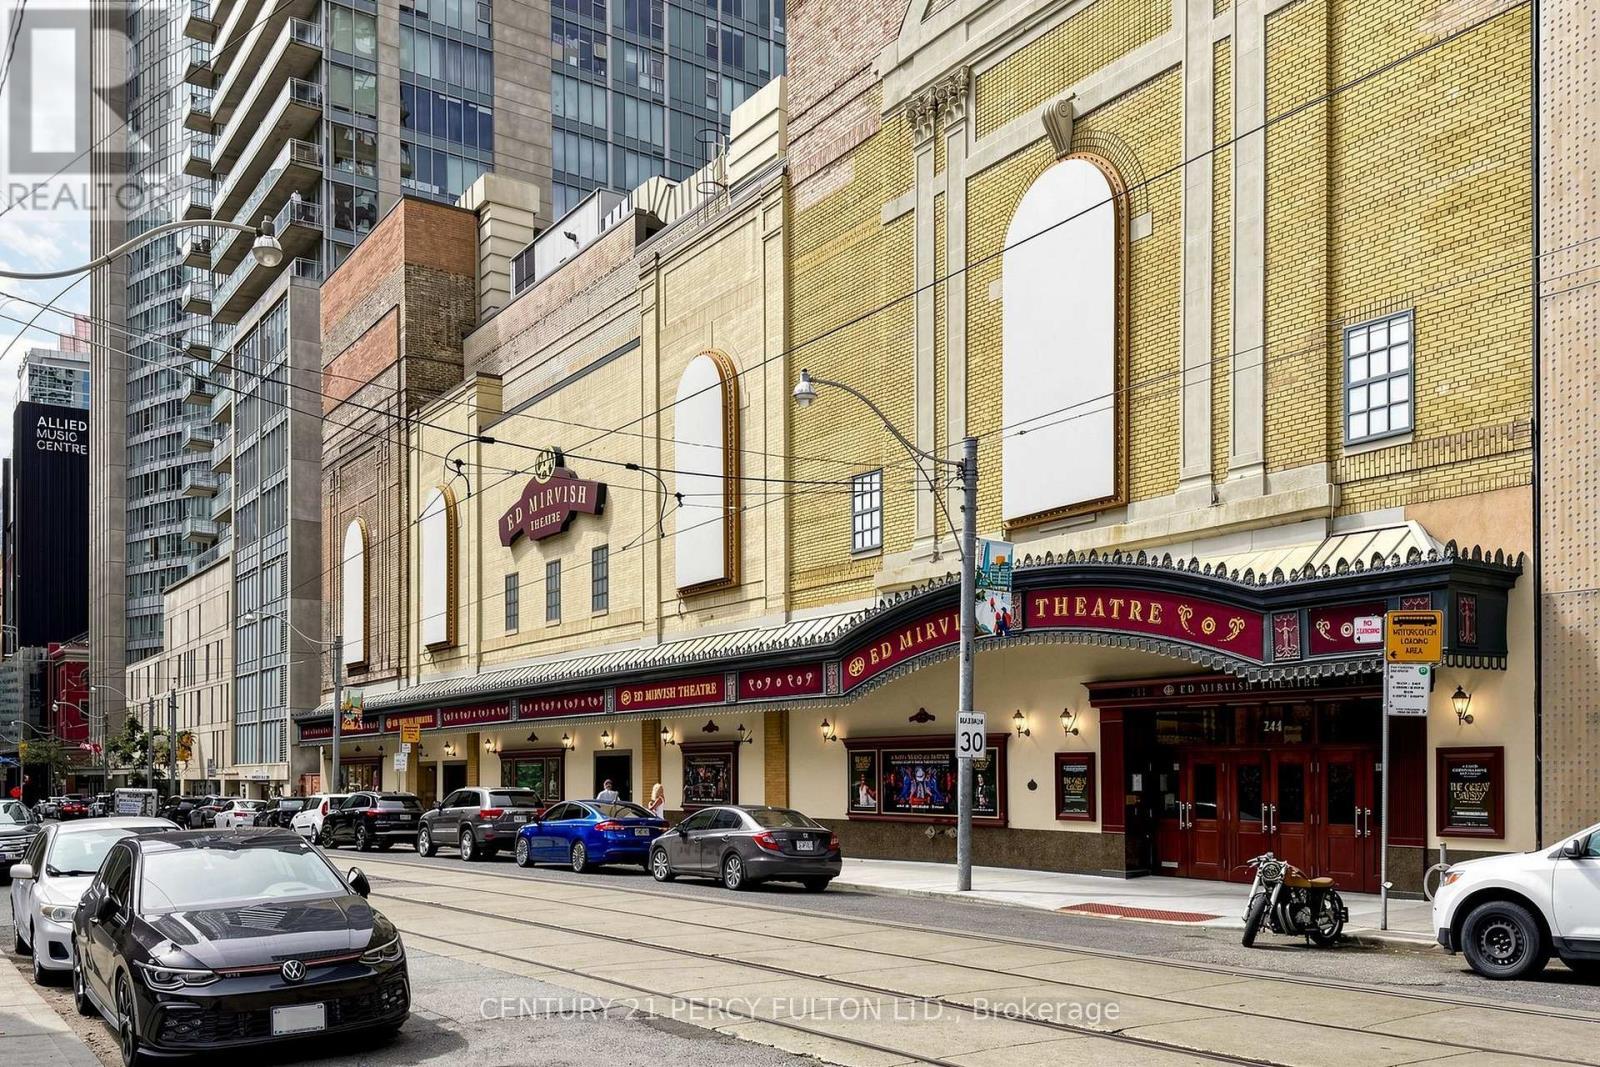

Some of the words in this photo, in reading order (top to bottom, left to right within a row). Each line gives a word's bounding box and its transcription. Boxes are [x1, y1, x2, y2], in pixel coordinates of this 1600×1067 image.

[37, 416, 87, 431] ALLIED
[36, 428, 78, 442] MUSIC
[36, 440, 88, 455] CENTRE
[507, 507, 522, 531] ED
[529, 485, 587, 514] MIRVISH
[1035, 597, 1163, 624] THEATRE
[870, 642, 892, 665] ED
[900, 614, 960, 651] MIRVI
[634, 691, 643, 702] ED
[645, 687, 676, 701] MIRVISH
[678, 682, 717, 698] THEATRE
[1180, 684, 1194, 694] ED
[1200, 682, 1253, 694] MIRVISH
[1264, 720, 1283, 732] 244
[960, 731, 983, 752] 30
